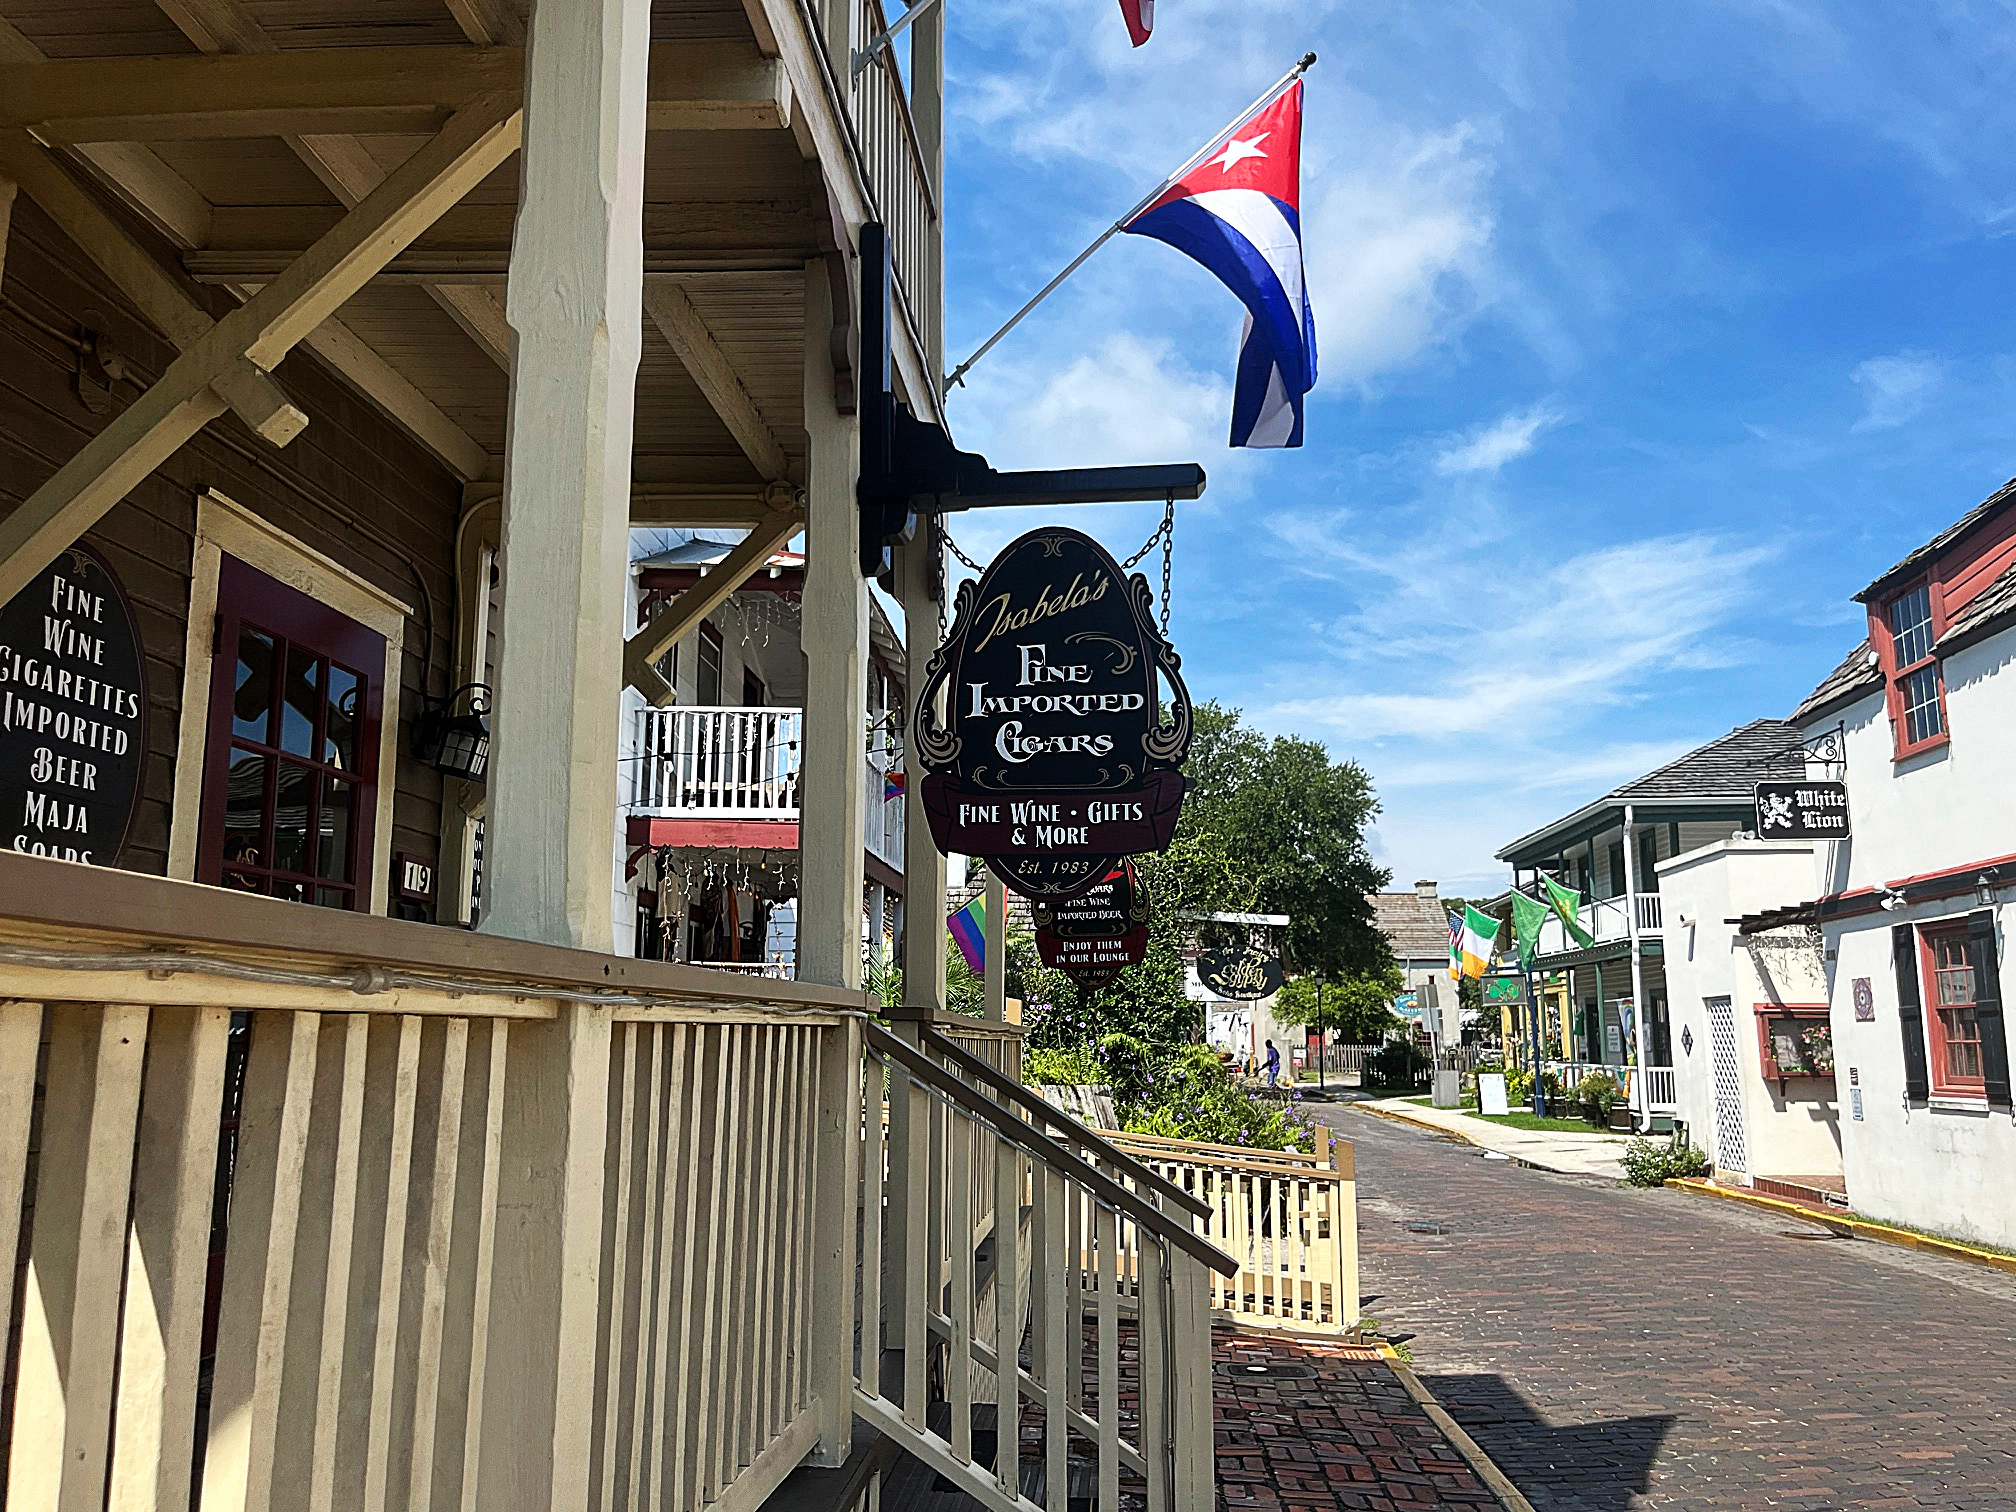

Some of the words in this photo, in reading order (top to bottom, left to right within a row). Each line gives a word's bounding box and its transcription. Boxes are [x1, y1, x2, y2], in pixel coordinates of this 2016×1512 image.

[51, 574, 105, 624] FINE
[974, 569, 1110, 653] Isabela's
[44, 614, 106, 666] WINE
[1015, 643, 1093, 687] FINE
[965, 681, 1144, 718] IMPORTED
[3, 691, 128, 756] IMPORTED
[995, 720, 1114, 763] CIGARS
[30, 747, 97, 791] BEER
[23, 790, 88, 834] MAJA
[959, 803, 1000, 828] FINE
[1010, 799, 1061, 827] WINE
[1087, 801, 1143, 824] GIFTS
[1794, 789, 1845, 811] White
[1801, 810, 1844, 829] Lion
[1011, 827, 1027, 846] &
[1035, 825, 1089, 849] MORE
[408, 865, 429, 892] 19
[1017, 859, 1043, 874] Est.
[1051, 860, 1090, 874] 1983
[1088, 897, 1111, 906] WINE
[1056, 954, 1066, 964] IN
[1070, 954, 1090, 963] OUR
[1093, 952, 1130, 963] LOUNGE
[1063, 941, 1092, 952] ENJOY
[1096, 940, 1122, 950] THEM
[1092, 969, 1110, 977] 1983
